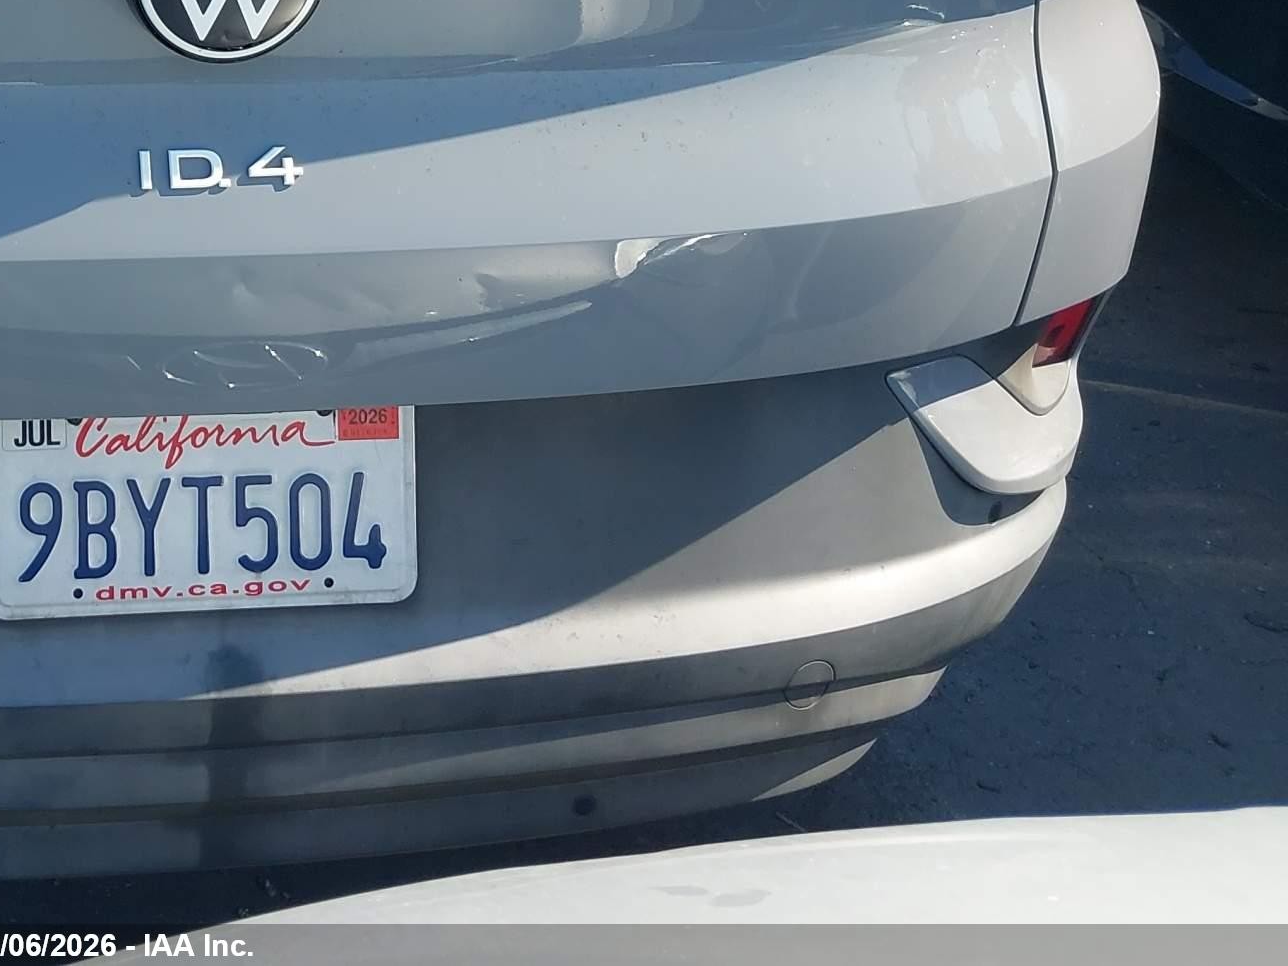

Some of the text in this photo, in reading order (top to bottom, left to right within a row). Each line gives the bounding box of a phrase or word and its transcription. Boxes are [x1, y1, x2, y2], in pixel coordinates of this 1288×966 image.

[348, 407, 389, 425] 2026
[13, 419, 62, 448] JUL
[75, 414, 336, 470] California
[18, 471, 388, 583] 9BYT504
[95, 578, 311, 601] dmv.ca.gov
